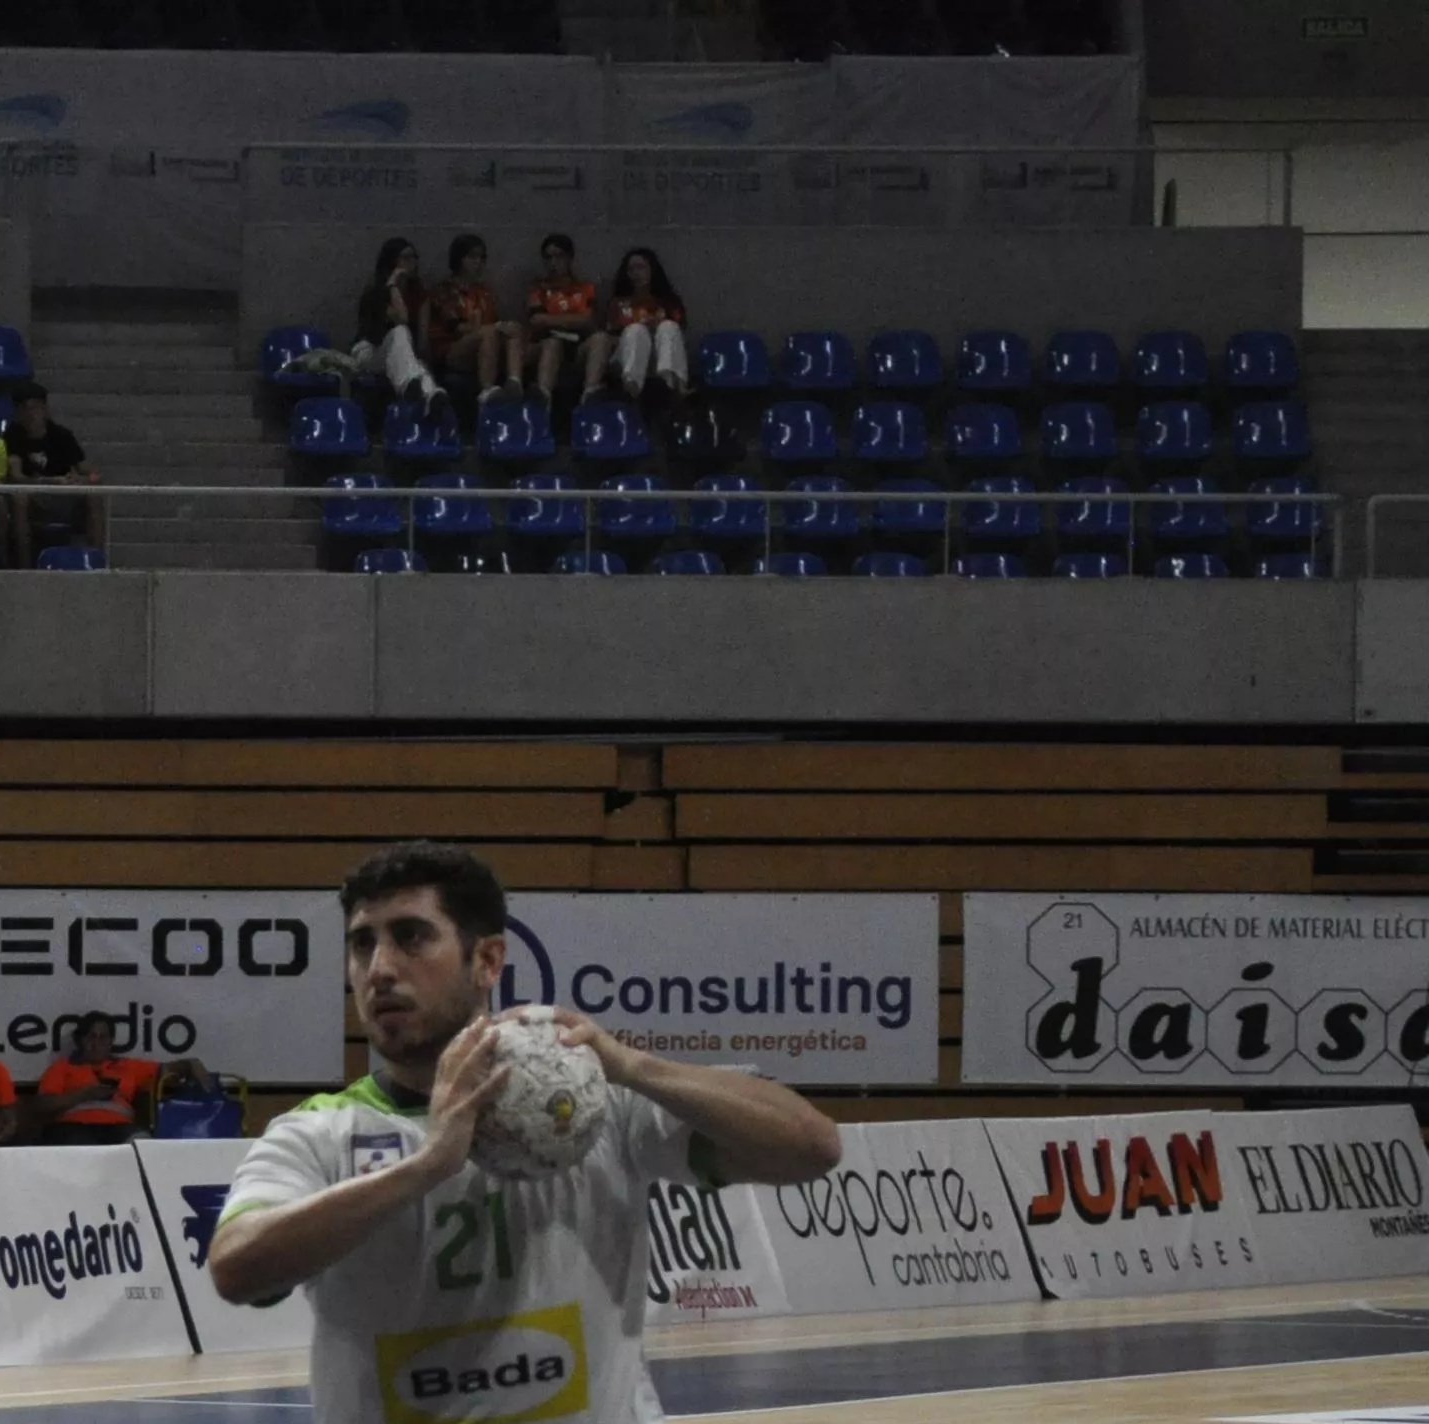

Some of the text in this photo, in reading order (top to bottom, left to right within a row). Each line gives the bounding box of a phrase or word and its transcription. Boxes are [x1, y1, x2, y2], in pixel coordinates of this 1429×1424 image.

[1062, 914, 1083, 929] 21
[1129, 913, 1227, 939] ALMACÉN
[1234, 917, 1261, 939] DE
[1267, 917, 1364, 939] MATERIAL
[571, 961, 912, 1031] Consulting
[608, 1028, 867, 1057] ficiencia energética
[1027, 1130, 1224, 1225] JUAN
[1237, 1138, 1423, 1215] EL DIARIO
[435, 1191, 515, 1292] 21
[892, 1238, 1011, 1287] cantabria
[409, 1351, 565, 1400] Bada
